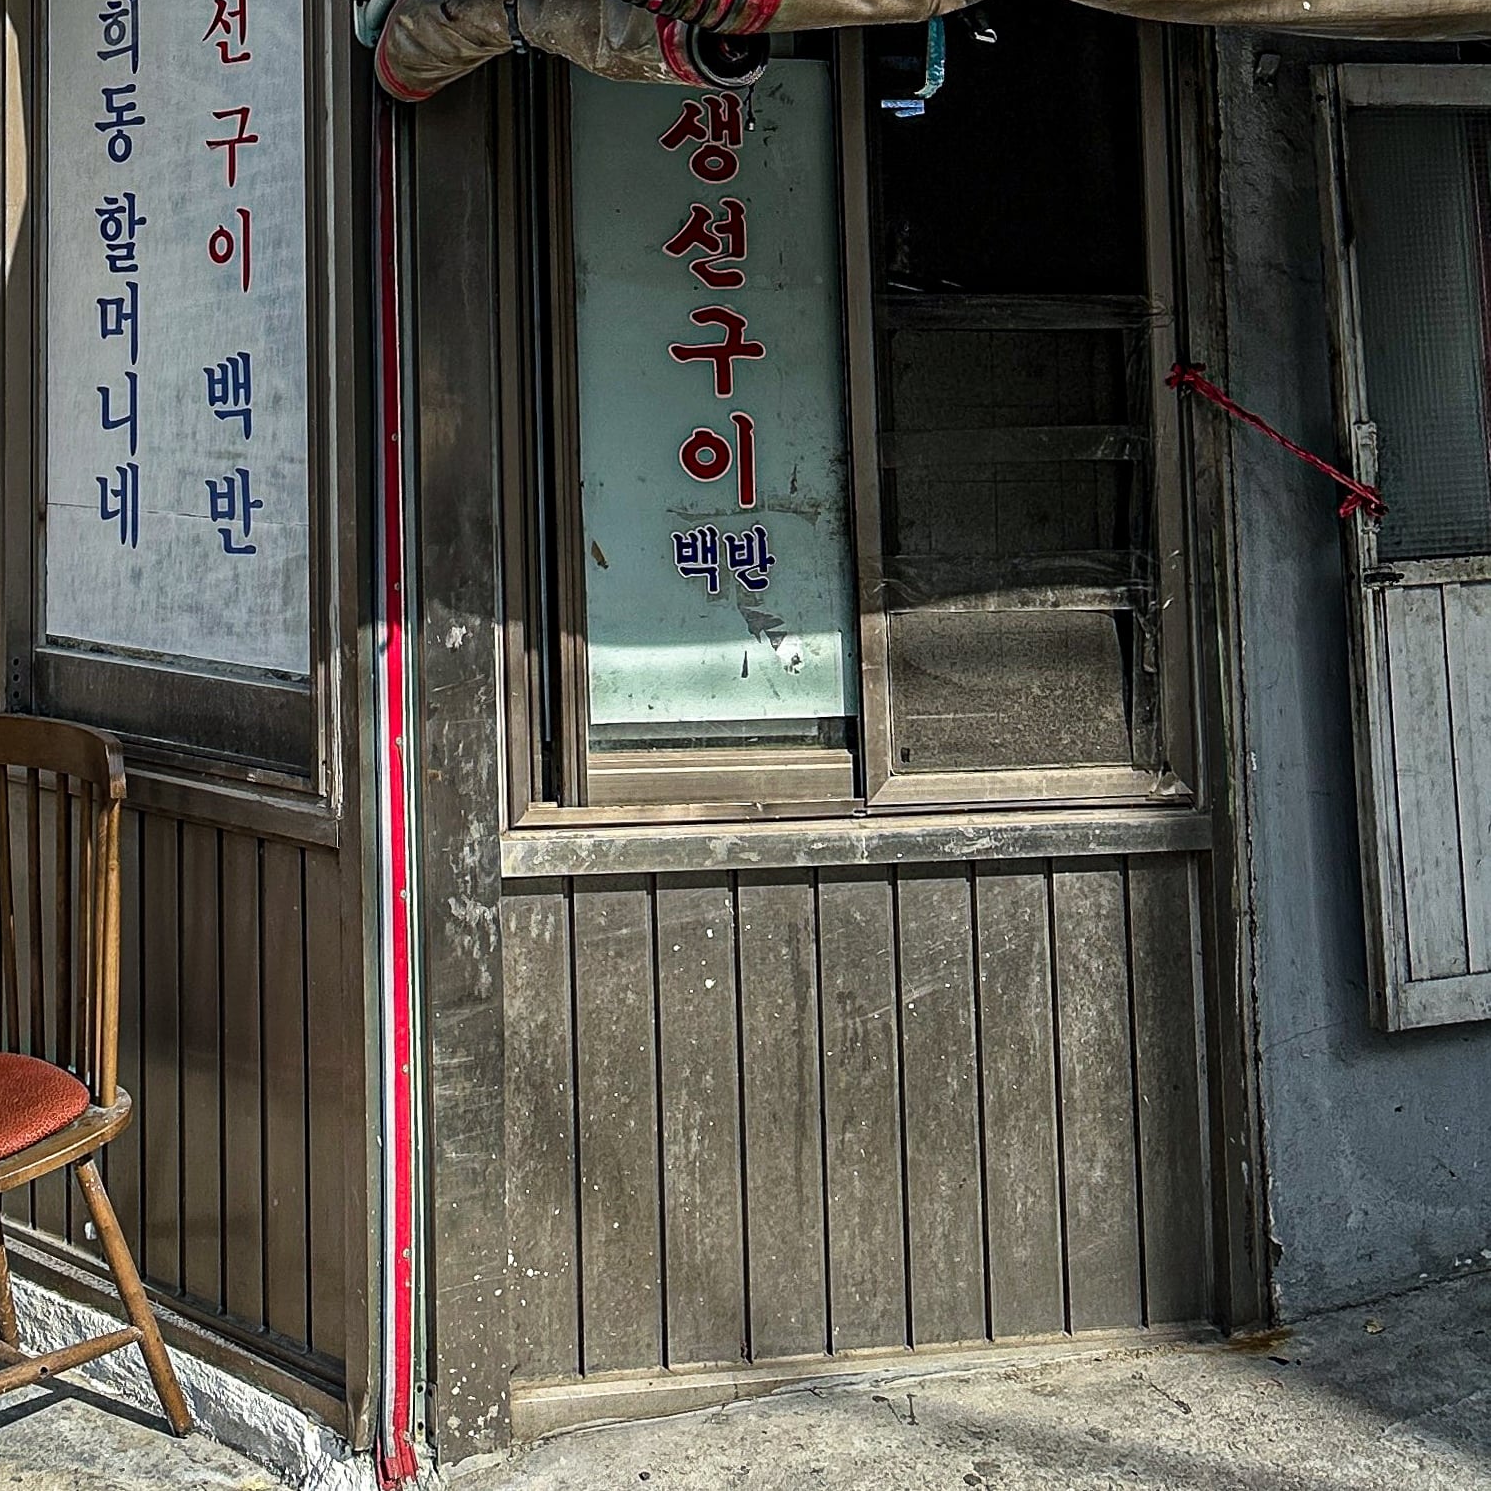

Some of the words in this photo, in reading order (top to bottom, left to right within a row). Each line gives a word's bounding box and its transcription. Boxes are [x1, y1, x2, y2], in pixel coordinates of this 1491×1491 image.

[95, 192, 146, 551] 할머니네
[659, 91, 766, 509] 생선구이
[202, 351, 263, 558] 백반
[671, 525, 776, 594] 백반
